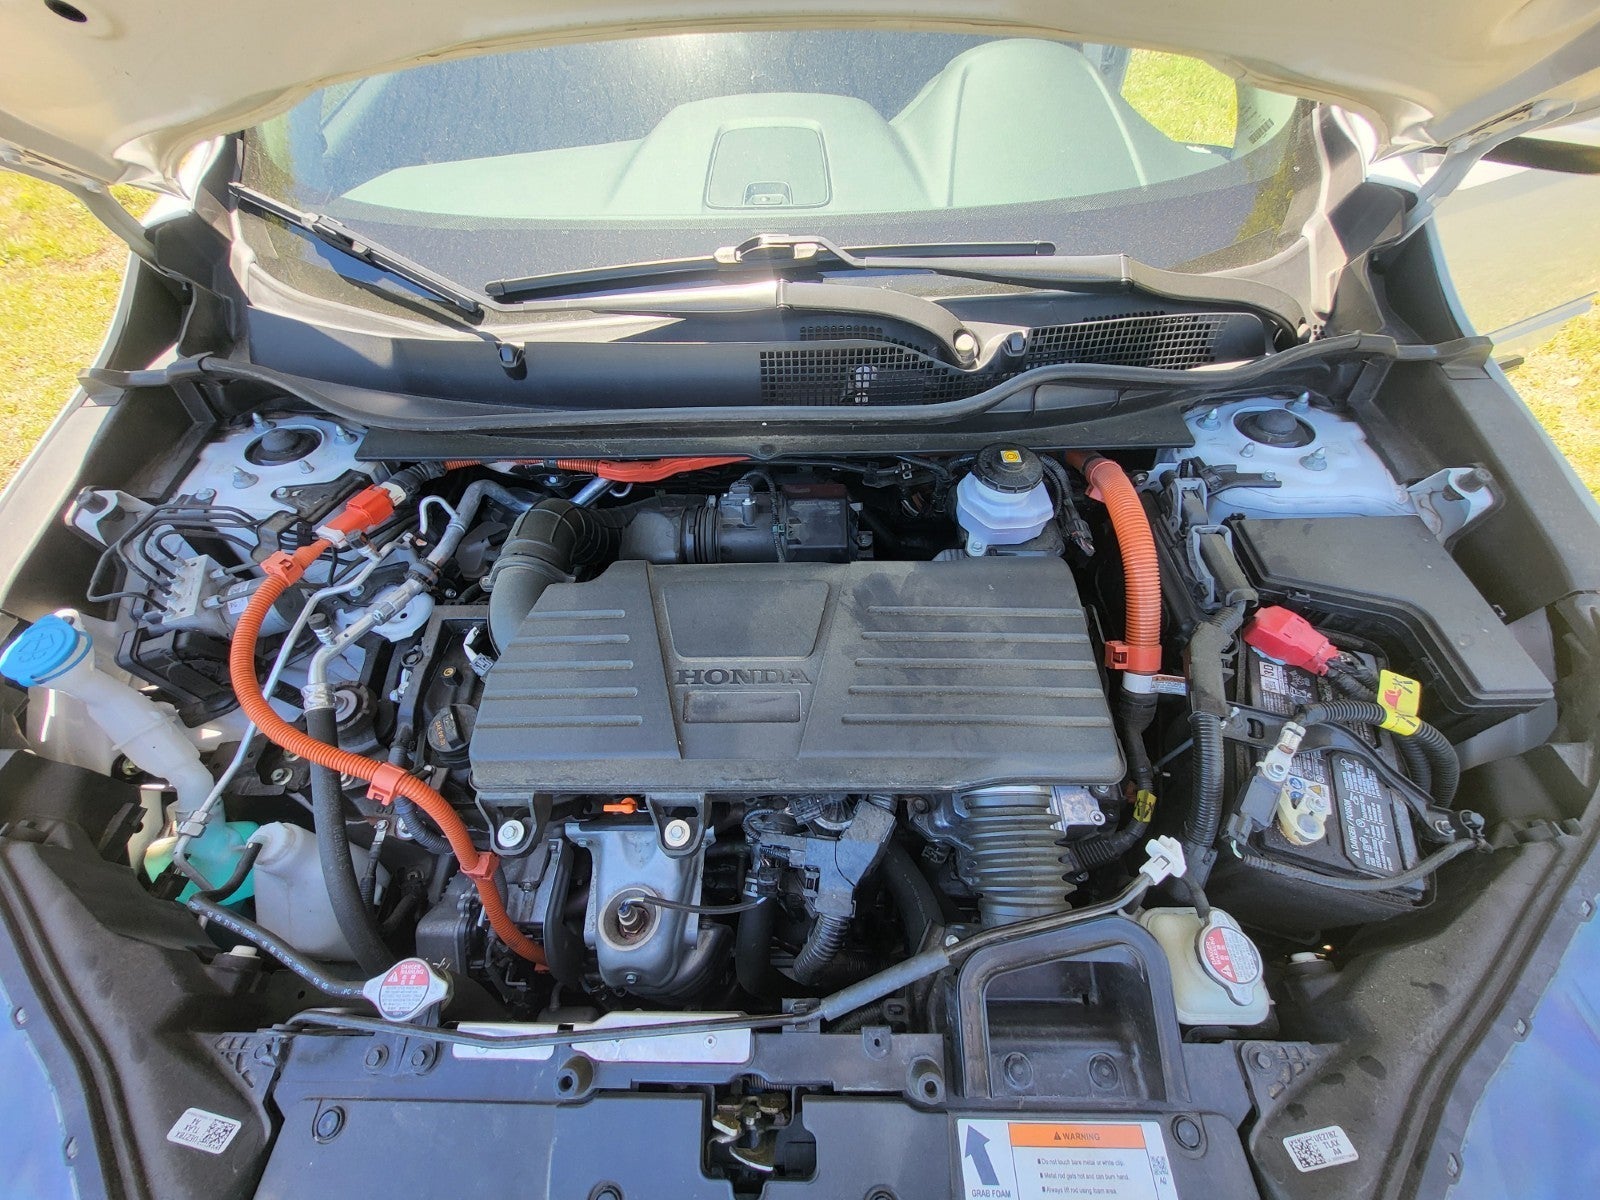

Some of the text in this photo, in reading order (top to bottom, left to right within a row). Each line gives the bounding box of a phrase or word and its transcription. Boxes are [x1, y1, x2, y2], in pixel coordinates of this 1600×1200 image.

[675, 668, 812, 685] HONDA
[1063, 1133, 1100, 1141] WARNING
[972, 1189, 1011, 1198] GRAB FOAM
